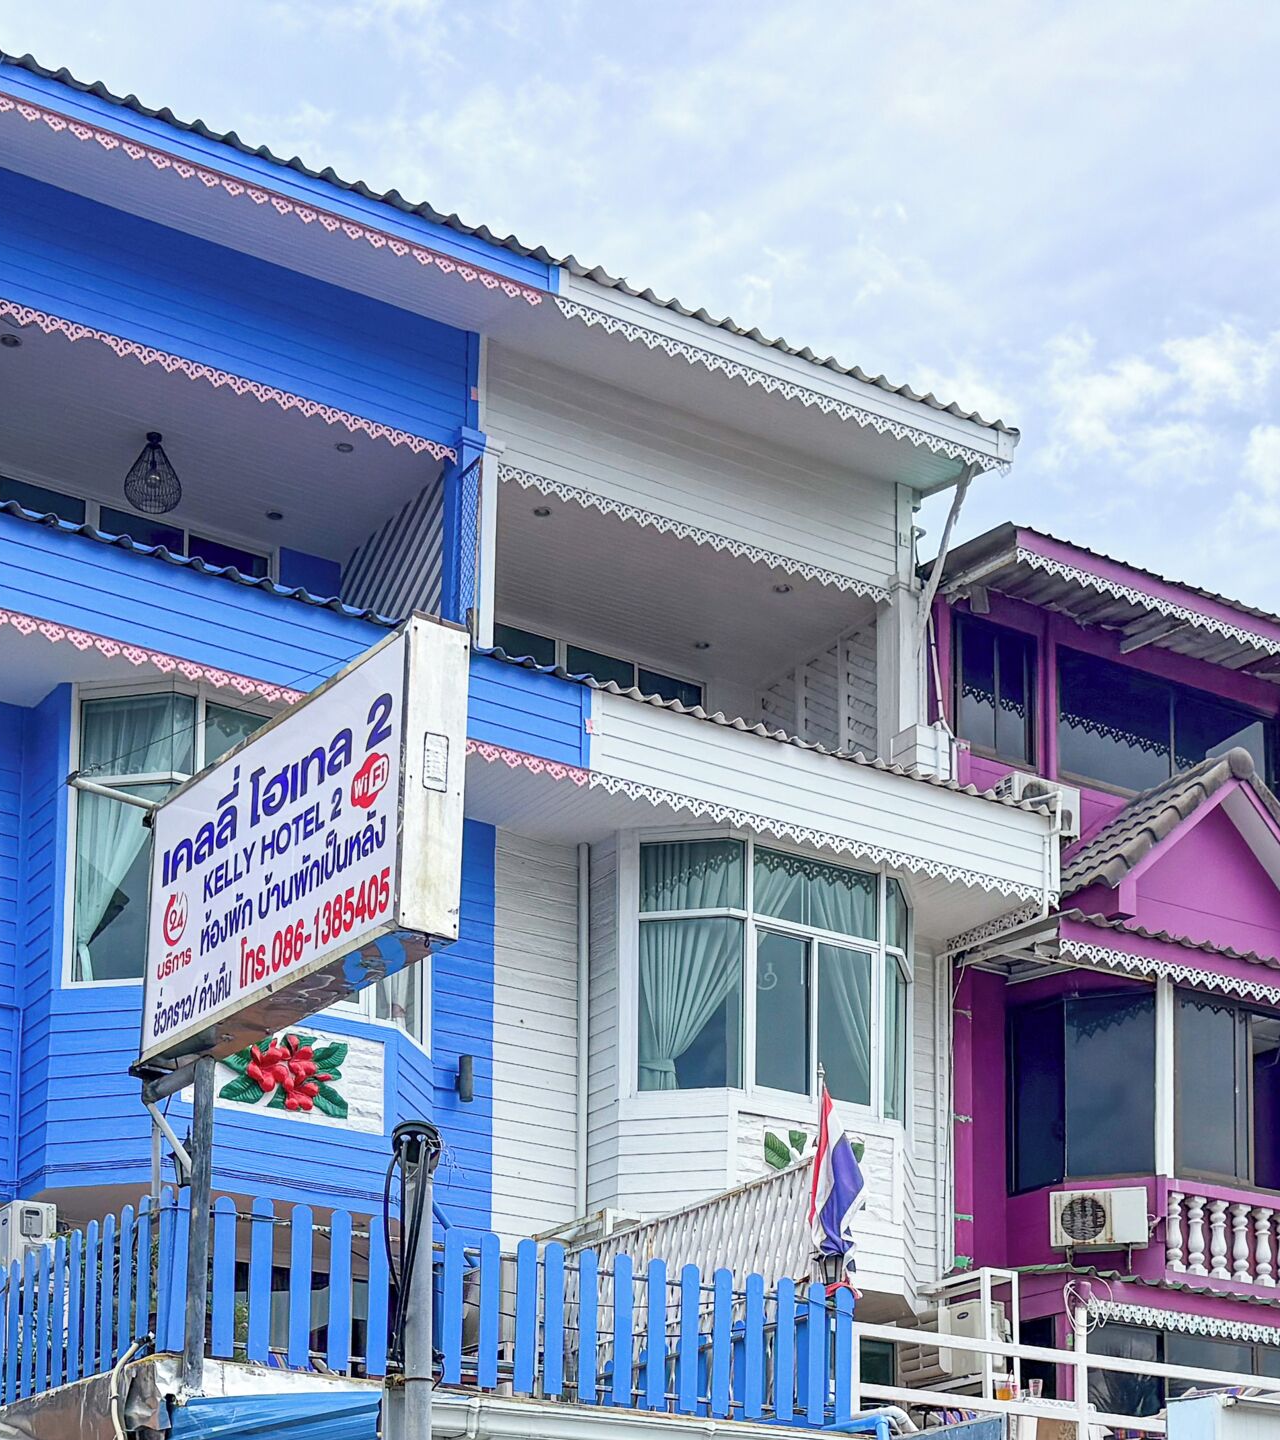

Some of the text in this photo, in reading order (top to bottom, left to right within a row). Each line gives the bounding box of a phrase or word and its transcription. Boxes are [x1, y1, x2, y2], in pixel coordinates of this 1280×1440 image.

[162, 765, 240, 888] เคลลี่
[250, 728, 352, 828] โฮเทล
[366, 693, 393, 753] 2
[203, 787, 343, 904] KELLY HOTEL 2
[170, 908, 184, 933] 24
[200, 810, 387, 957] ห้องพัก บ้านพักเป็นหลัง
[240, 866, 391, 990] โทร.086-1385405
[157, 947, 192, 980] บริการ
[198, 961, 232, 1014] ค้างคืน
